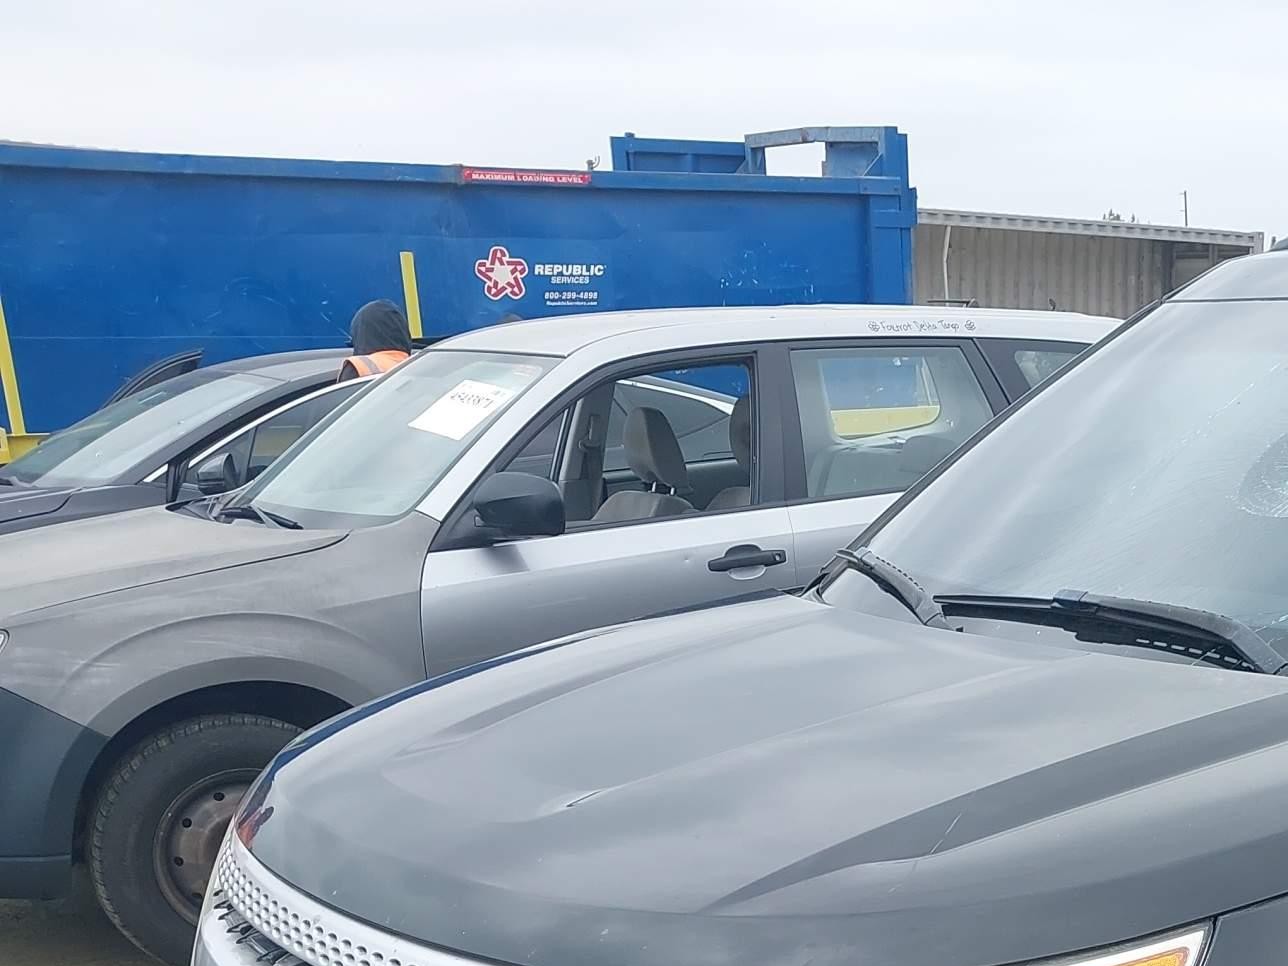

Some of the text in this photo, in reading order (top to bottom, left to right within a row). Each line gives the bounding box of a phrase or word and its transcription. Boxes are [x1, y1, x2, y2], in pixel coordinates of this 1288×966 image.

[471, 173, 584, 183] MAXIMUM LOADING LEVEL
[534, 264, 604, 275] REPUBLIC
[550, 276, 590, 284] SERVICES
[544, 291, 598, 299] 800-299-4898
